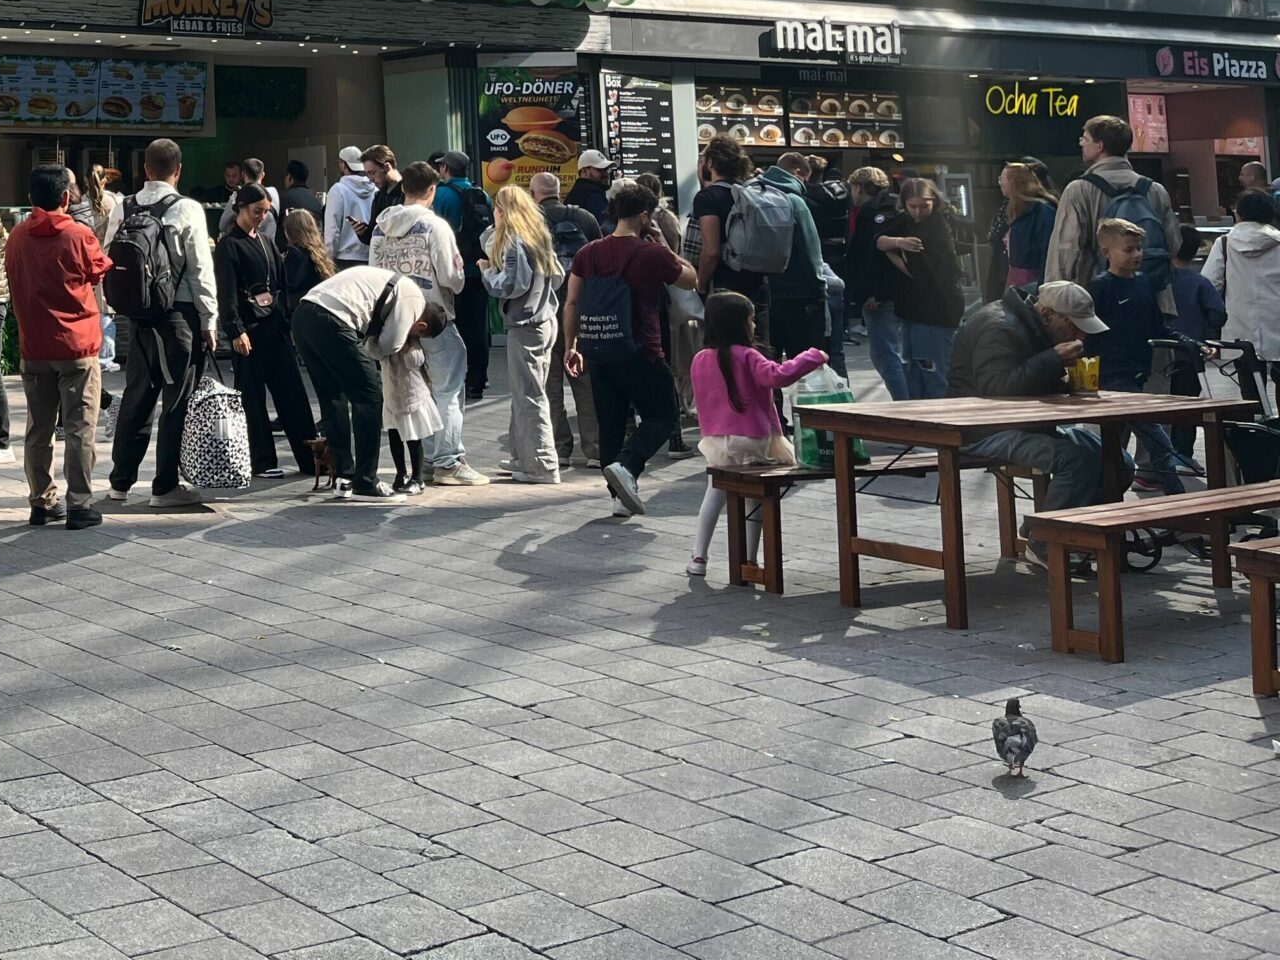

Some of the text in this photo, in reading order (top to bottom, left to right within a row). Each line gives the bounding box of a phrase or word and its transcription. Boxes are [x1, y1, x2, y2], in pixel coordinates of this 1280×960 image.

[173, 19, 242, 33] KEBAB & FRIES
[859, 54, 872, 64] good
[888, 56, 899, 64] food
[1183, 51, 1267, 78] Eis Piazza
[606, 75, 621, 87] Box
[985, 81, 1079, 117] Ocha Tea
[490, 133, 508, 141] UFO
[517, 165, 560, 173] RUNDUM
